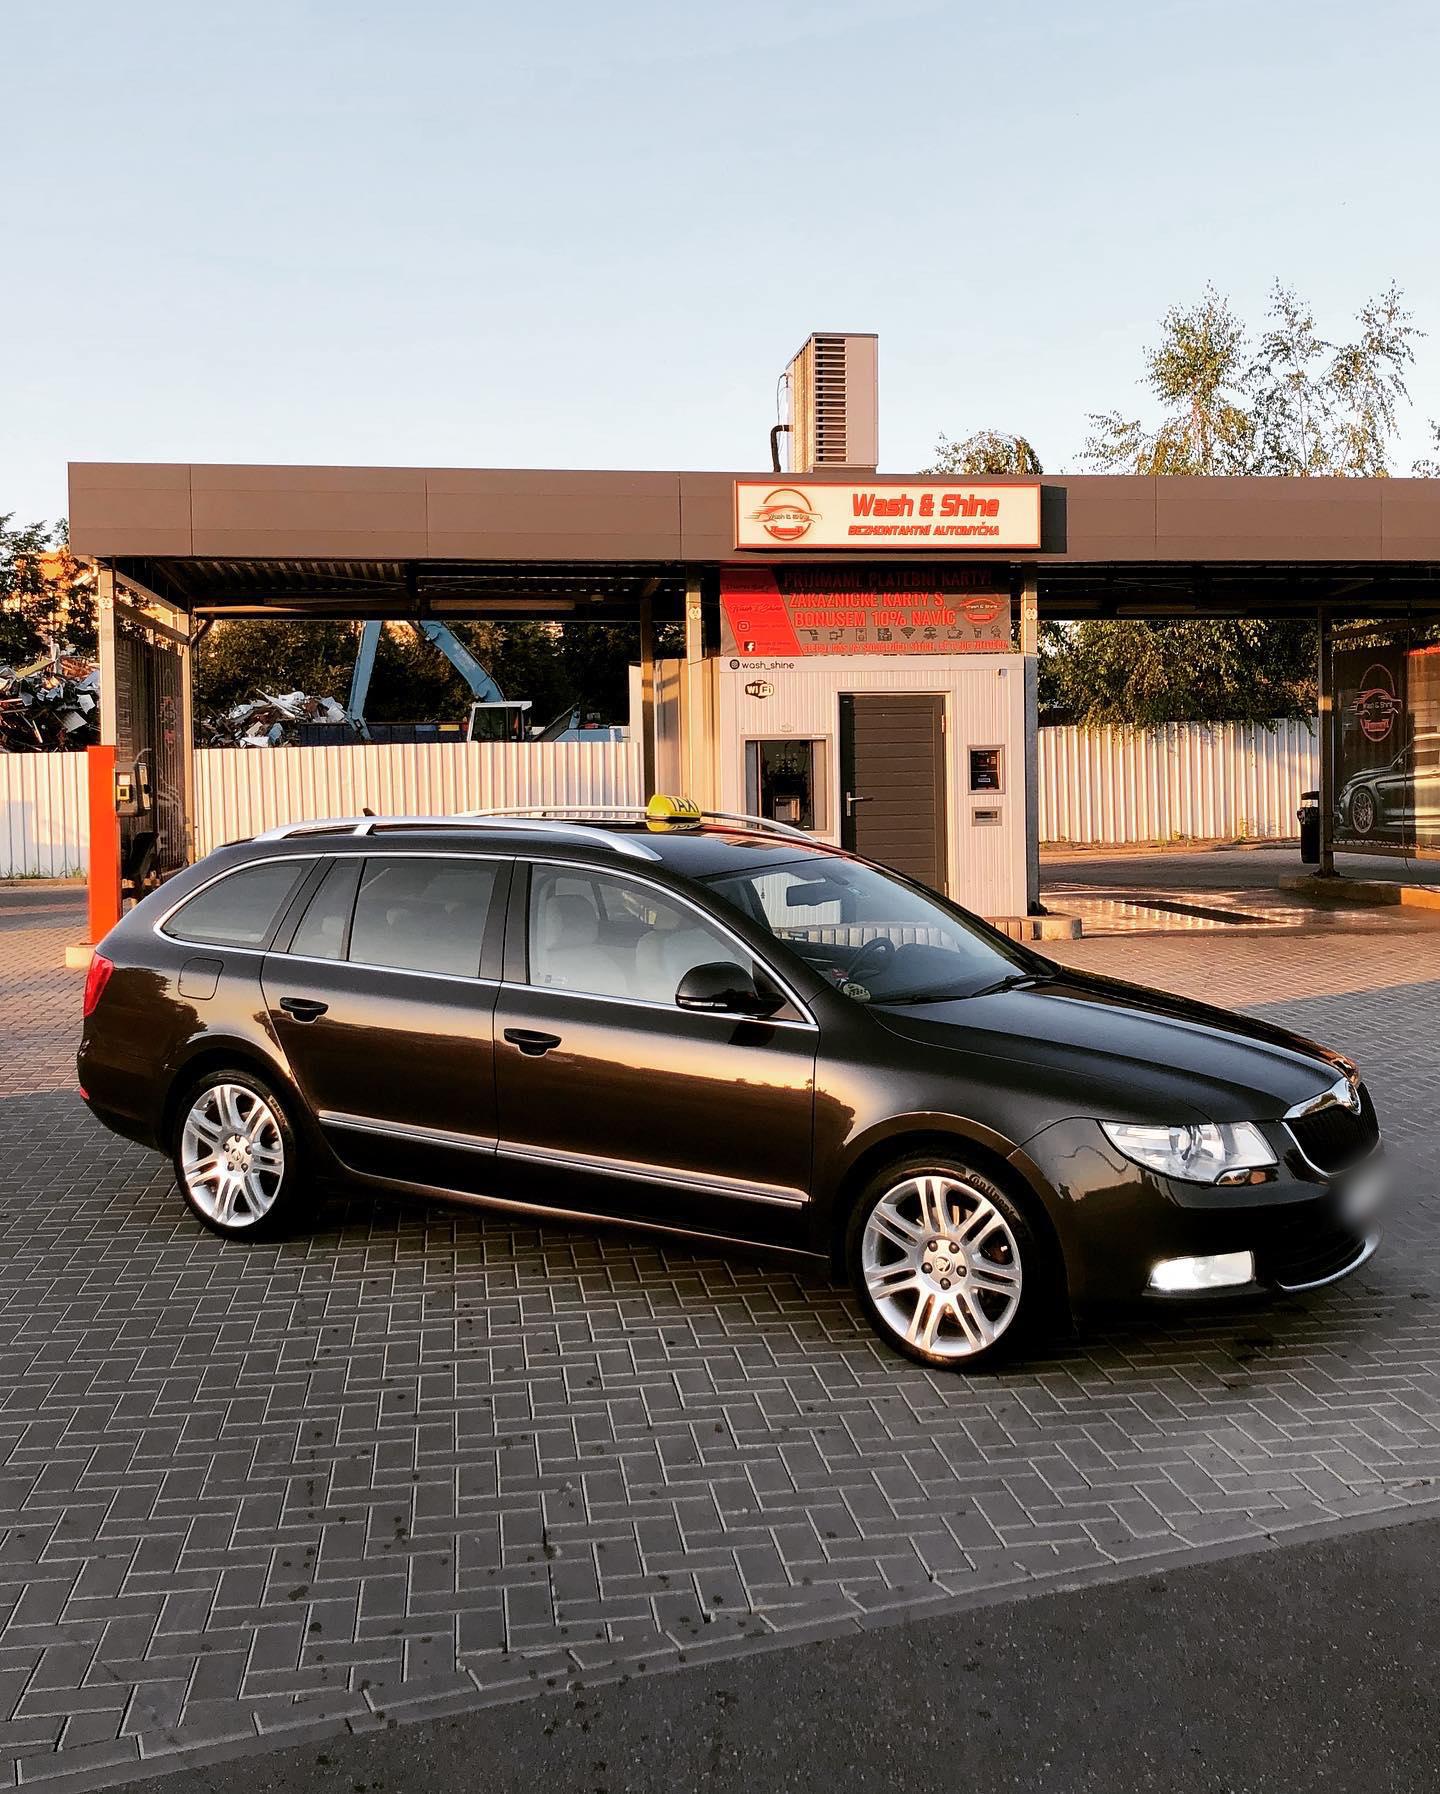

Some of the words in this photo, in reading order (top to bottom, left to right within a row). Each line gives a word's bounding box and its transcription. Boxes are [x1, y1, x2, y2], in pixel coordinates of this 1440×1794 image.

[852, 493, 914, 517] Wash
[919, 493, 935, 517] &
[939, 493, 1000, 517] Shine
[883, 592, 929, 607] KARTY
[934, 591, 945, 606] S
[794, 611, 867, 627] BONUSEM
[872, 611, 908, 627] 10%
[911, 606, 957, 626] NAVÍC
[741, 660, 795, 670] wash_shine
[666, 796, 700, 813] TAXI
